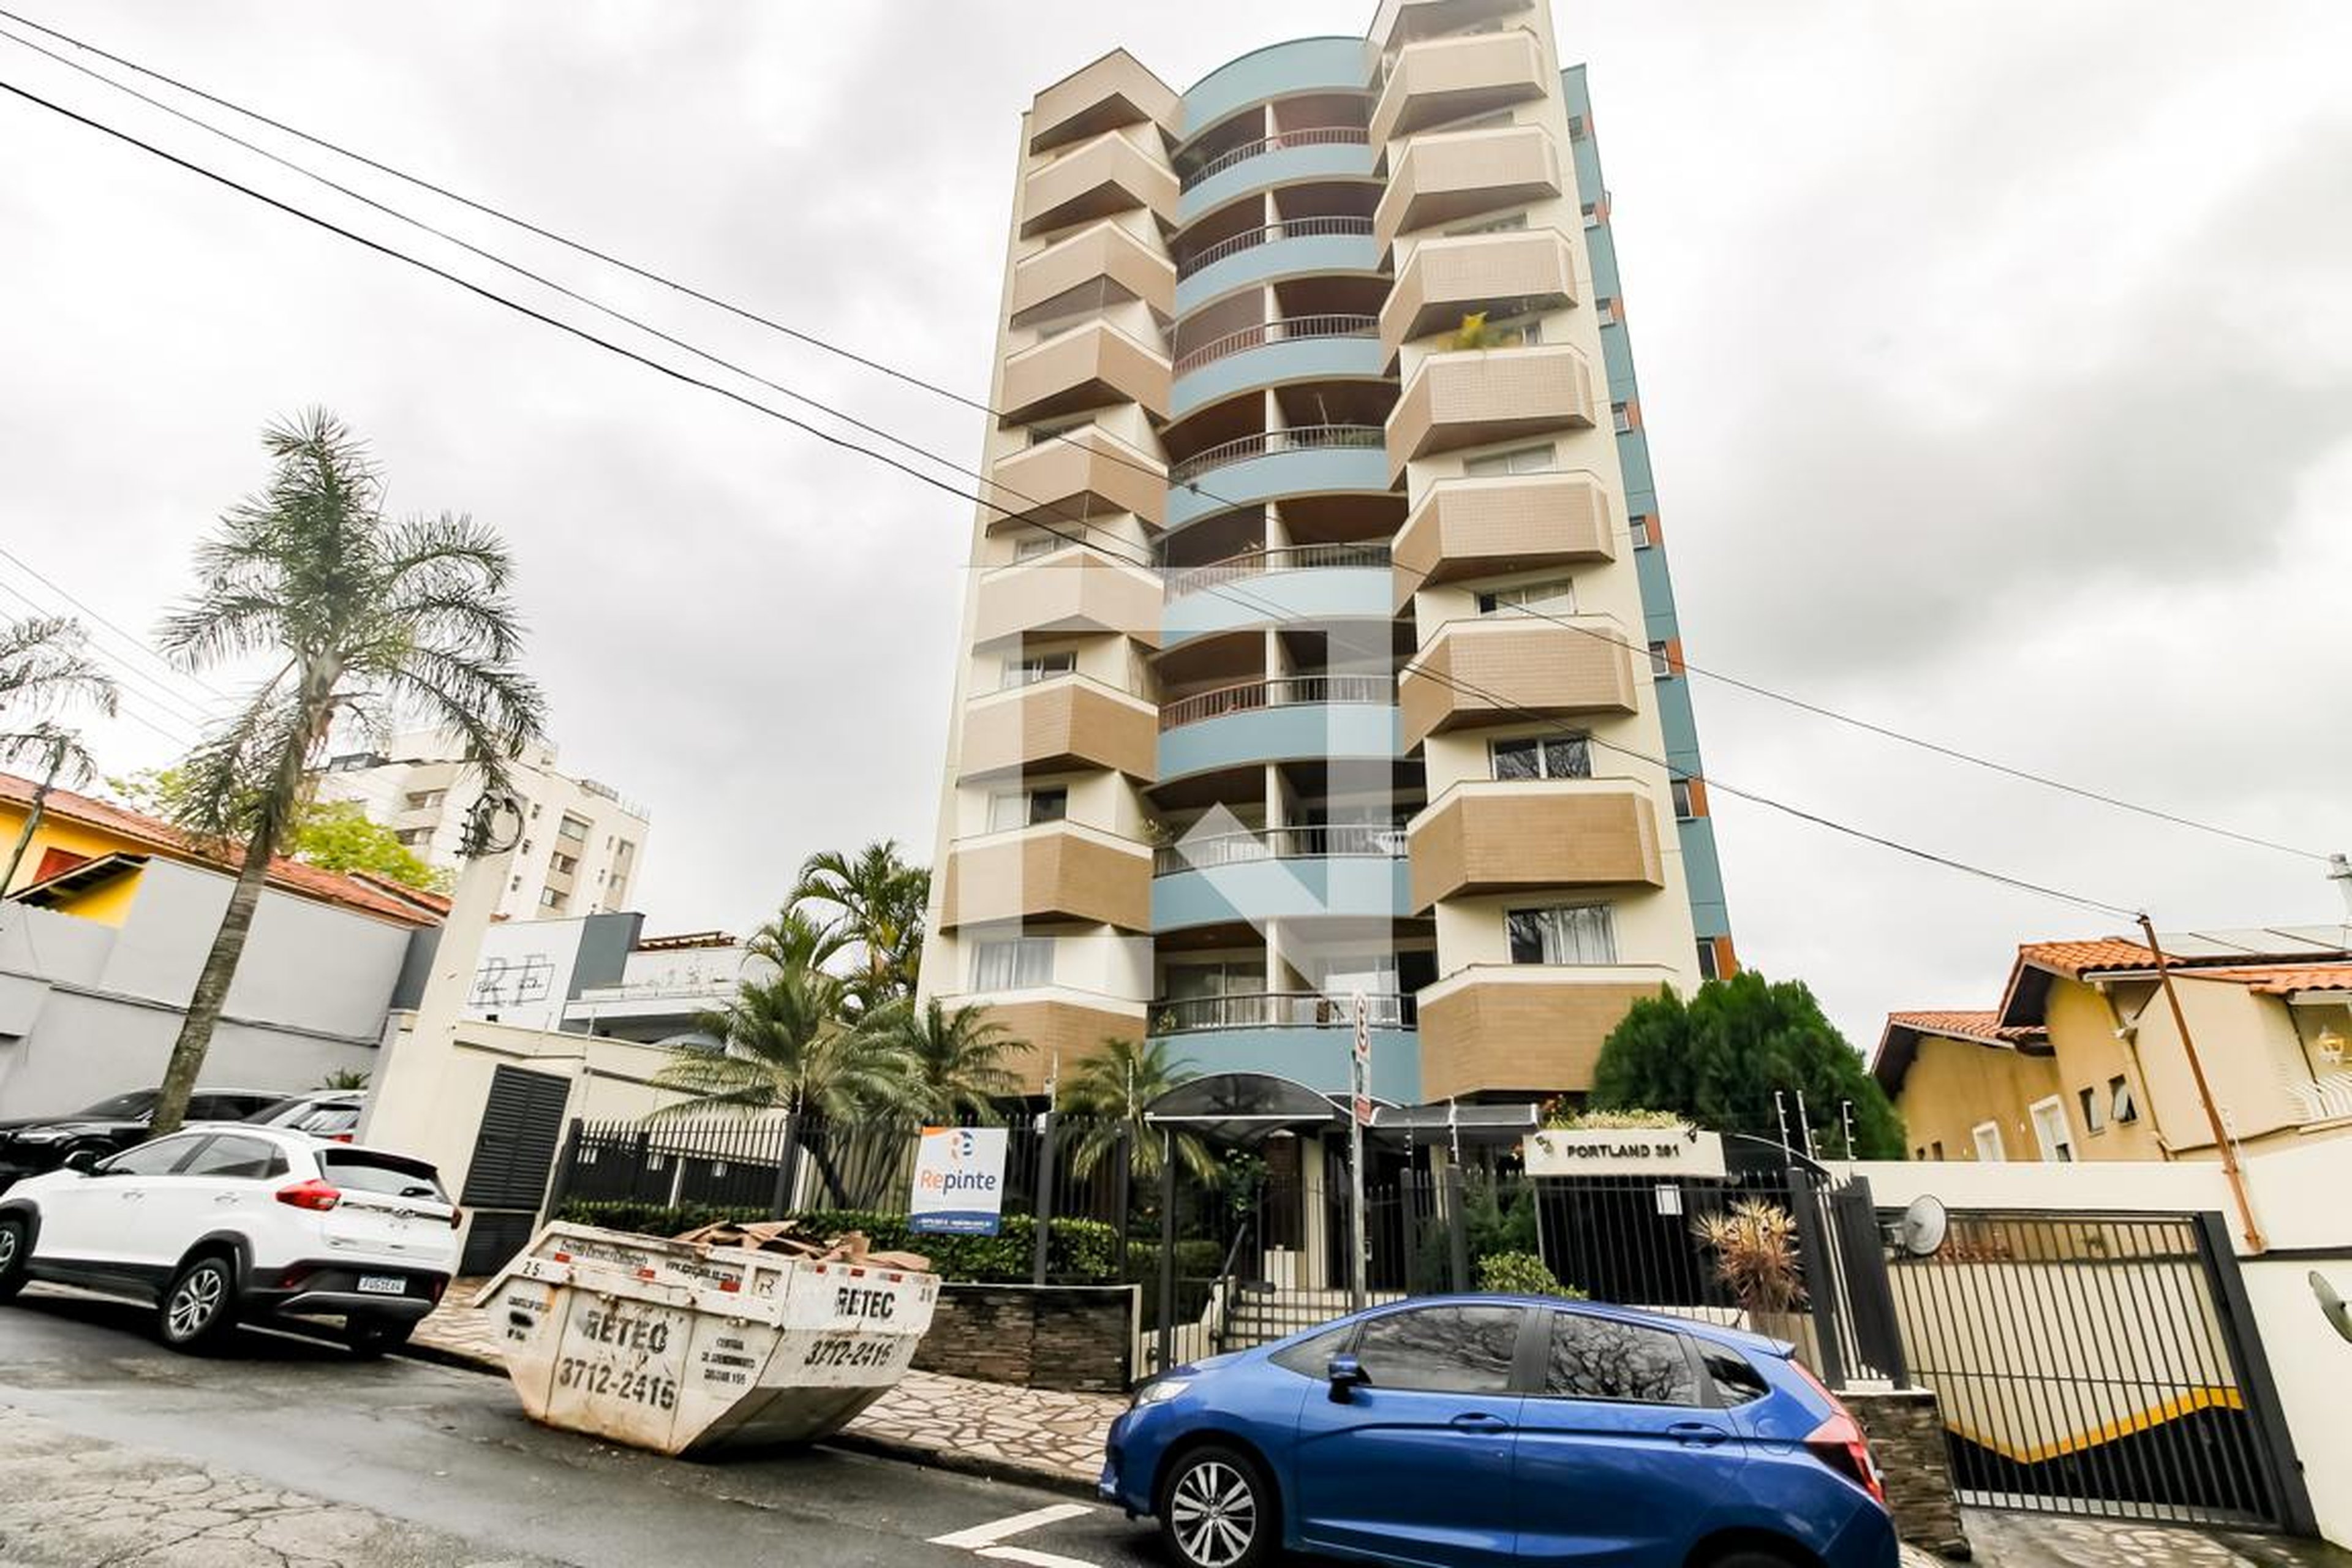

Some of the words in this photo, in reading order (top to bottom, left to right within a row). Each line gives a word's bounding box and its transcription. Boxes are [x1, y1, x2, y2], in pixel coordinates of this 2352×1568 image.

[1567, 1144, 1650, 1159] PORTLAND
[920, 1169, 997, 1196] Repinte
[559, 1357, 677, 1410] 3712-2416
